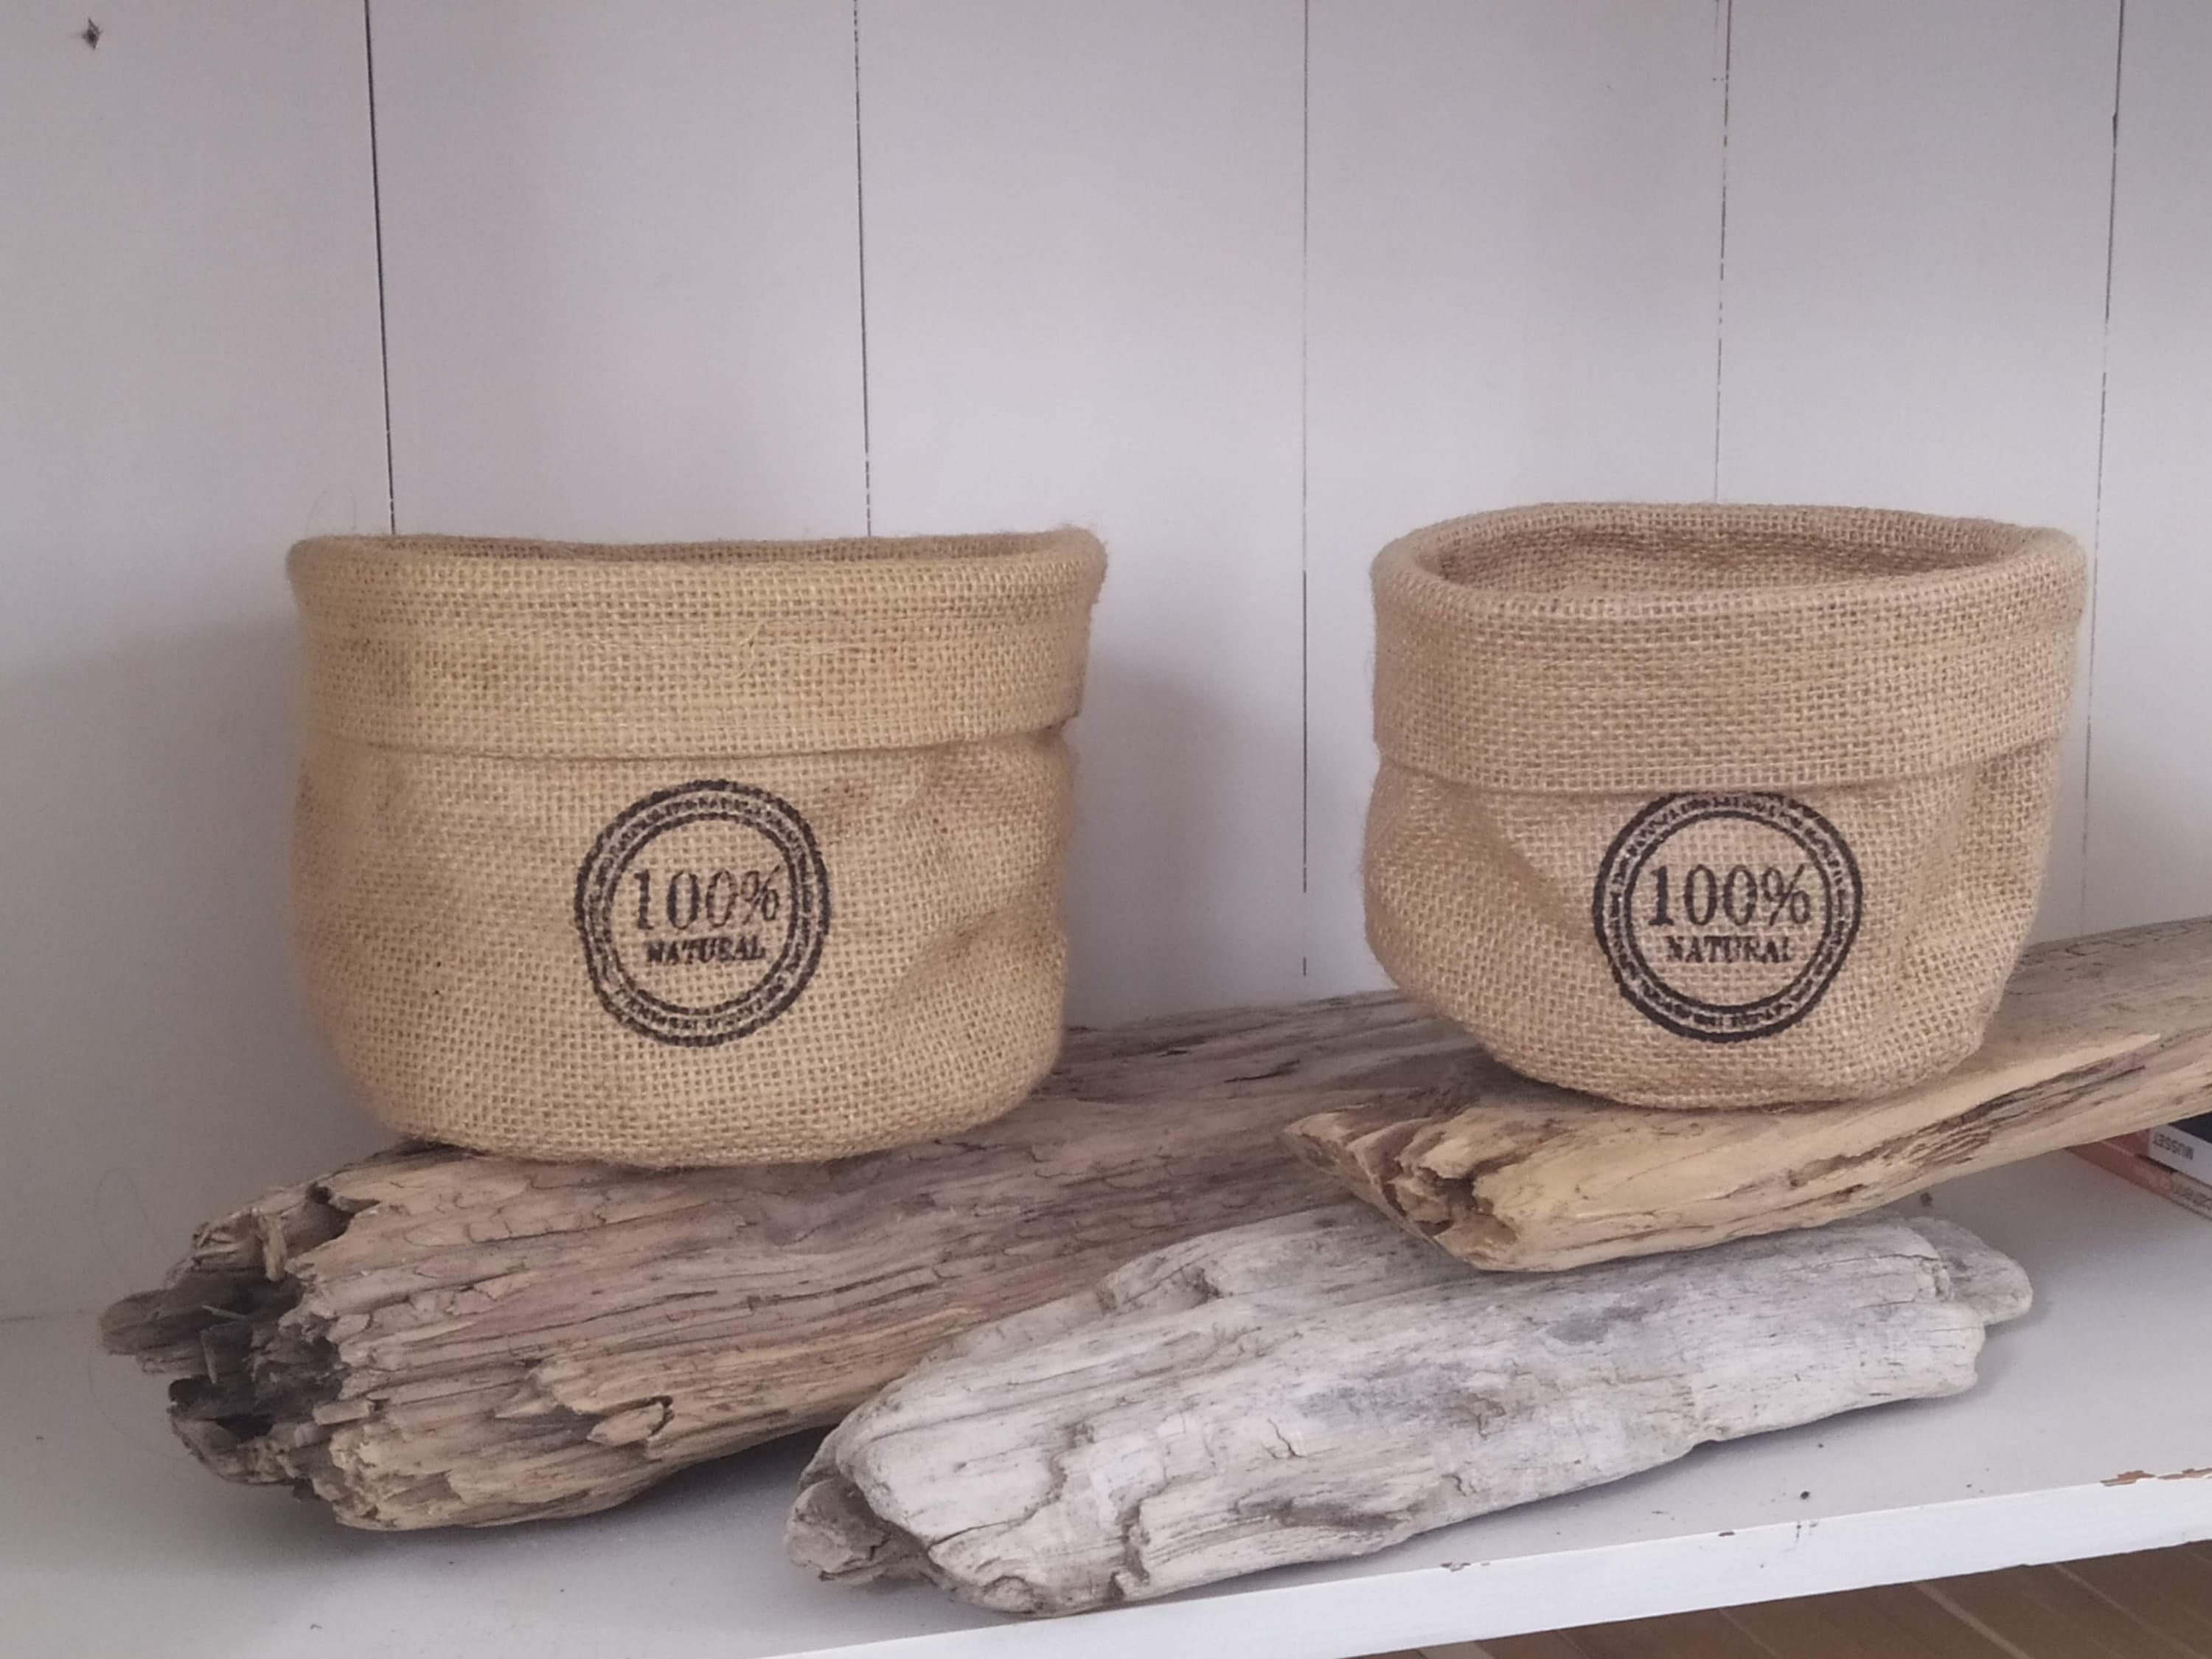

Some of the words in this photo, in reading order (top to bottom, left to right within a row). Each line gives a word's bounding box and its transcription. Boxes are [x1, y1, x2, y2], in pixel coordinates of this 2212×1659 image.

[634, 864, 780, 930] 100%
[1648, 863, 1811, 926] 100%
[646, 936, 766, 964] NATURAL
[1665, 934, 1790, 964] NATURAL
